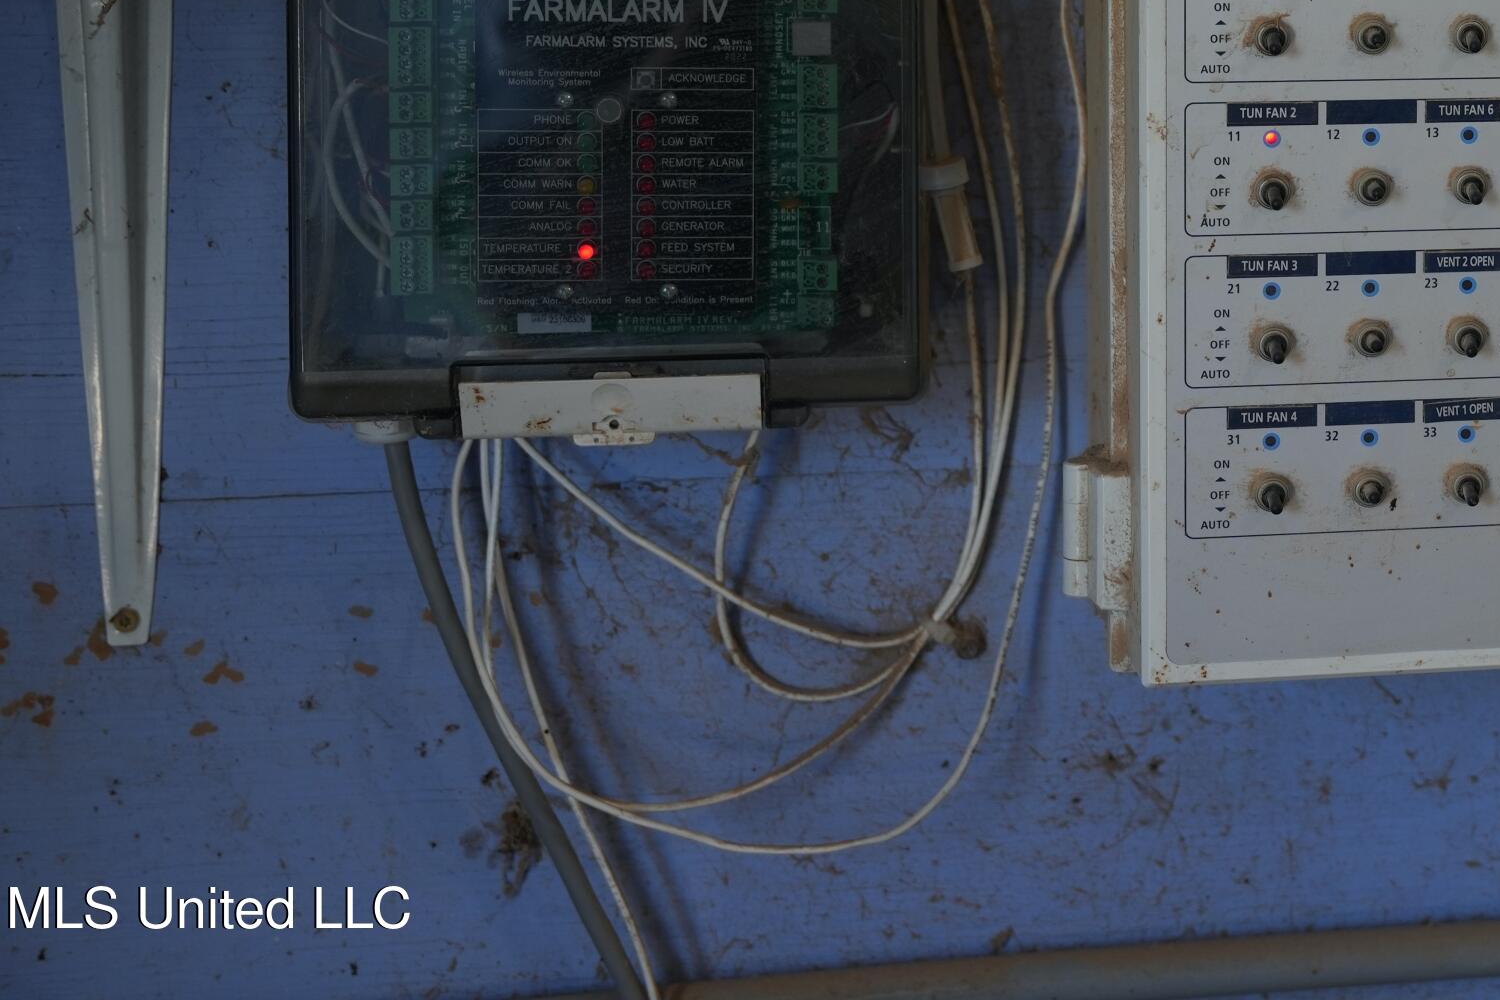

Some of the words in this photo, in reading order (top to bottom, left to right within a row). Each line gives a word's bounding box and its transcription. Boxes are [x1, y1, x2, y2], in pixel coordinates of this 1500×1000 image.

[701, 0, 729, 24] IV
[1213, 1, 1231, 13] ON
[526, 35, 606, 48] FARMALARM
[612, 36, 678, 49] SYSTEMS,
[684, 36, 708, 49] INC
[1210, 33, 1232, 44] OFF
[498, 69, 535, 78] Wireless
[540, 69, 601, 78] Environmental
[1200, 63, 1231, 75] AUTO
[508, 77, 554, 88] Monitoring
[559, 78, 591, 88] System
[668, 73, 746, 84] ACKNOWLEDGE
[1239, 107, 1263, 119] TUN
[1265, 106, 1287, 119] FAN
[1290, 106, 1297, 118] 2
[1438, 104, 1461, 117] TUN
[1463, 104, 1485, 116] FAN
[1487, 103, 1494, 115] 6
[533, 115, 573, 125] PHONE
[661, 115, 699, 125] POWER
[508, 136, 552, 146] OUTPUT
[555, 136, 573, 146] ON
[661, 137, 685, 146] LOW
[688, 137, 715, 146] BATT
[518, 158, 552, 168] COMM
[555, 158, 573, 168] OK
[661, 158, 705, 168] REMOTE
[708, 158, 745, 168] ALARM
[503, 179, 537, 189] COMM
[540, 179, 573, 189] WARN
[661, 179, 697, 189] WATER
[511, 200, 545, 210] COMM
[549, 200, 570, 210] FAIL
[661, 200, 732, 210] CONTROLLER
[529, 221, 573, 232] ANALOG
[661, 221, 725, 231] GENERATOR
[483, 243, 565, 253] TEMPERATURE
[661, 242, 688, 252] FEED
[693, 242, 736, 252] SYSTEM
[1241, 259, 1264, 272] TUN
[1266, 259, 1288, 272] FAN
[1291, 259, 1298, 271] 3
[1437, 256, 1461, 268] VENT
[1462, 256, 1469, 267] 2
[1469, 255, 1495, 267] OPEN
[481, 264, 562, 274] TEMPERATURE
[565, 264, 573, 274] 2
[661, 263, 713, 274] SECURITY
[1436, 405, 1460, 418] VENT
[1462, 405, 1467, 417] 1
[1468, 403, 1494, 416] OPEN
[1240, 411, 1263, 424] TUN
[1266, 411, 1288, 423] FAN
[1290, 411, 1298, 423] 4
